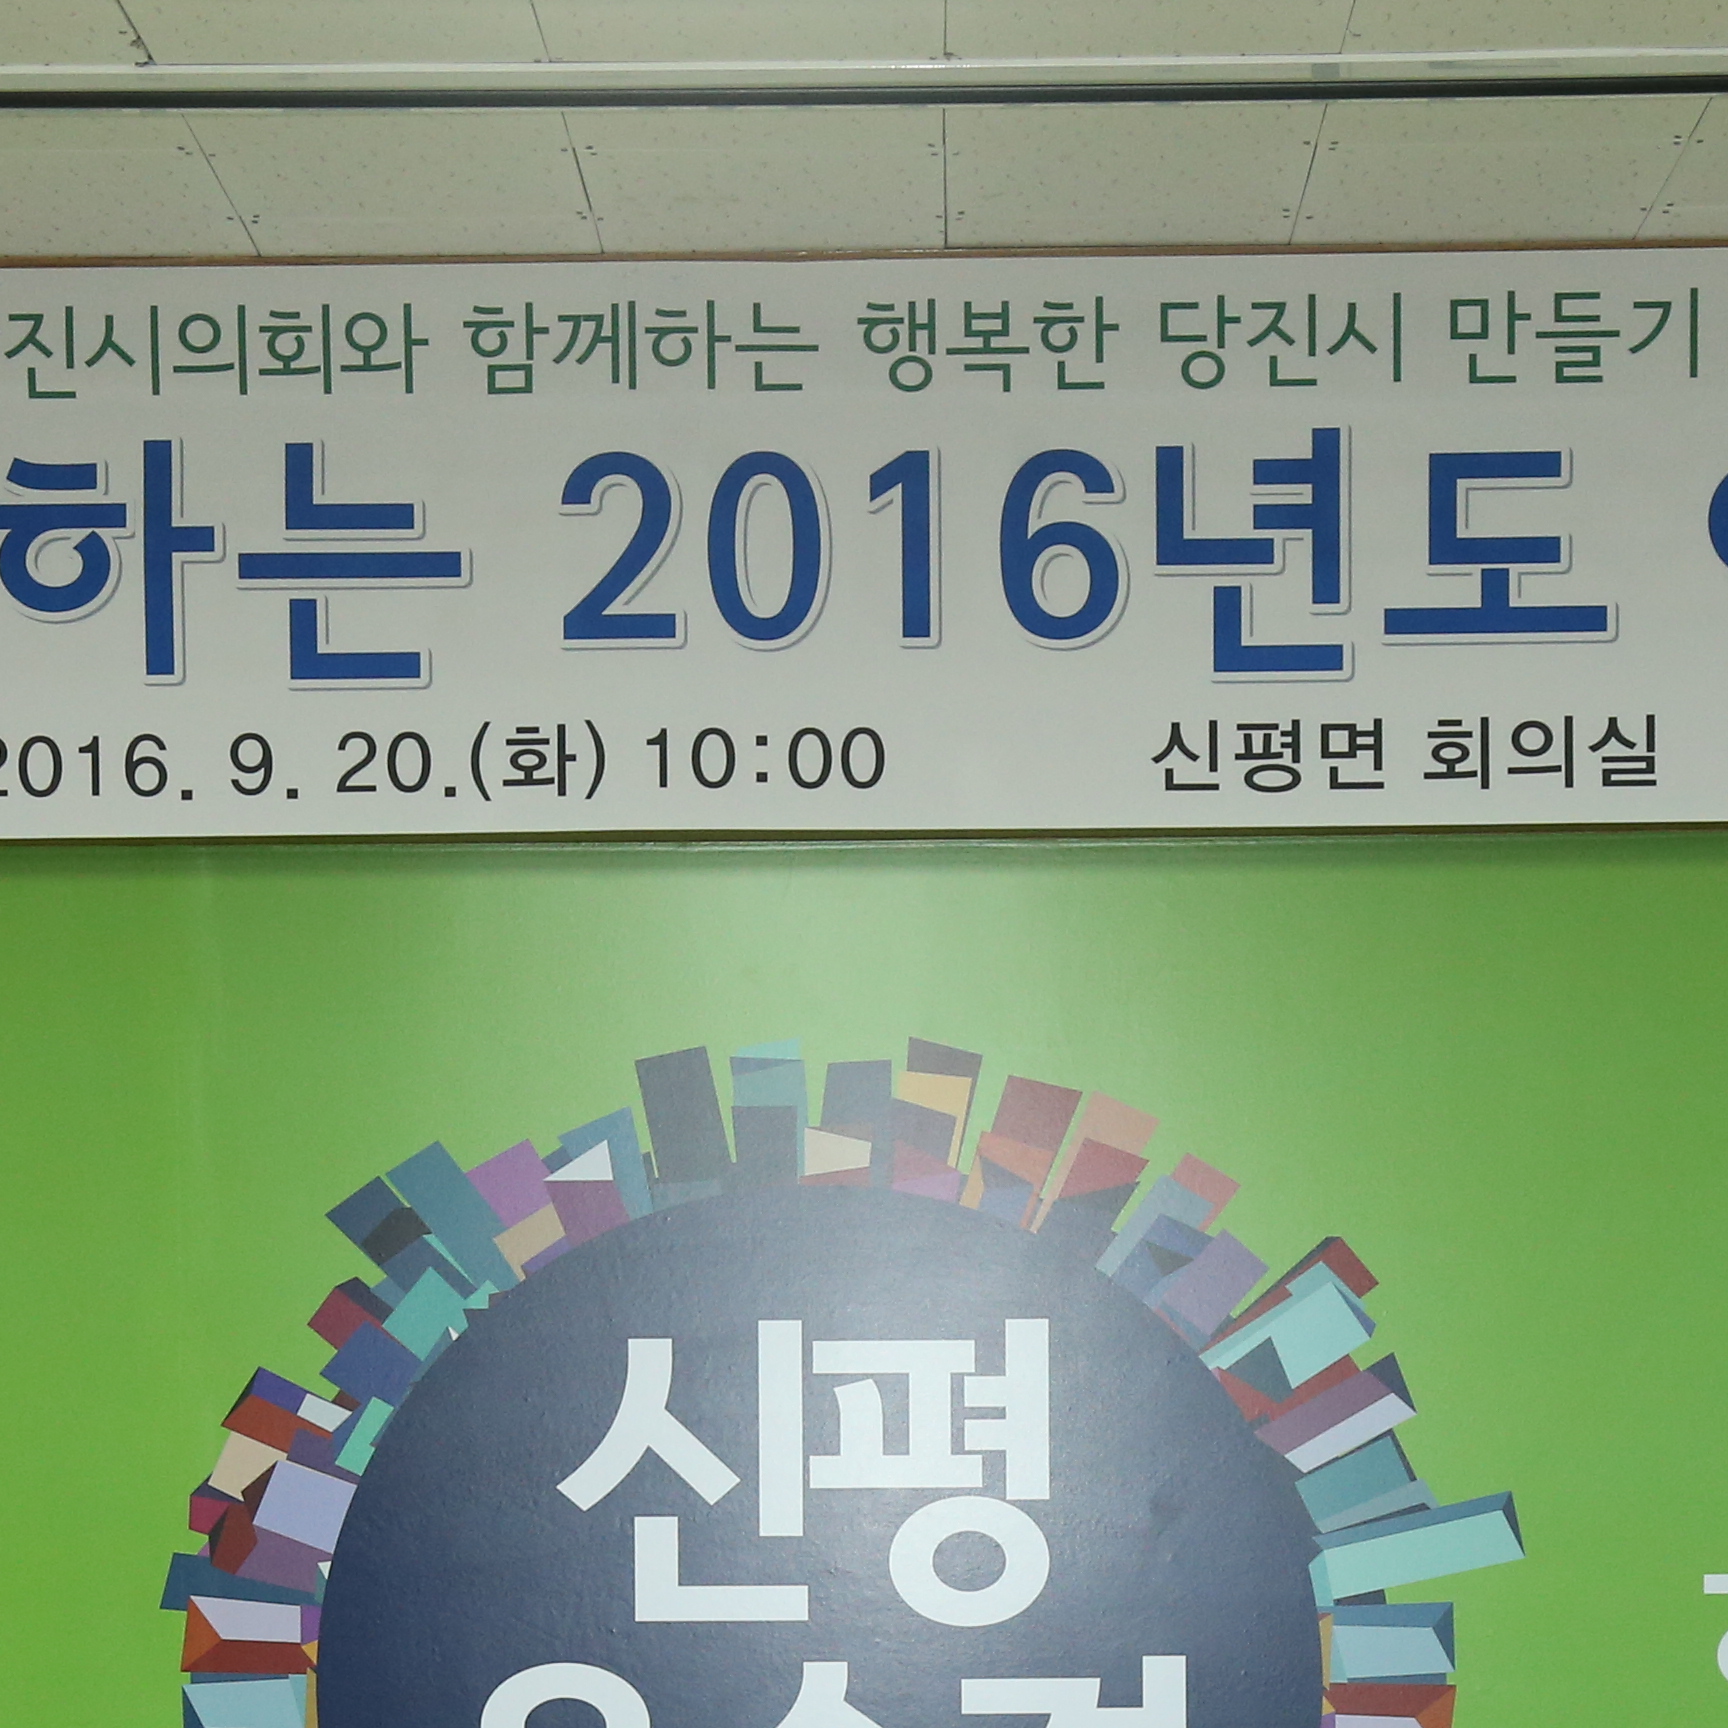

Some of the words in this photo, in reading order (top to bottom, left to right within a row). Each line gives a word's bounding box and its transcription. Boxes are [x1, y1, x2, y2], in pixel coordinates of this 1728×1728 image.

[463, 299, 820, 396] 함께하는
[857, 293, 1120, 394] 행복한
[1158, 291, 1404, 390] 당진시
[1448, 287, 1701, 385] 만들기
[559, 426, 1612, 675] 2016년도
[229, 731, 300, 799] 9.
[645, 725, 887, 790] 10:00
[1150, 717, 1386, 793] 신평면
[1422, 713, 1658, 789] 회의실
[555, 1316, 1052, 1628] 신평
